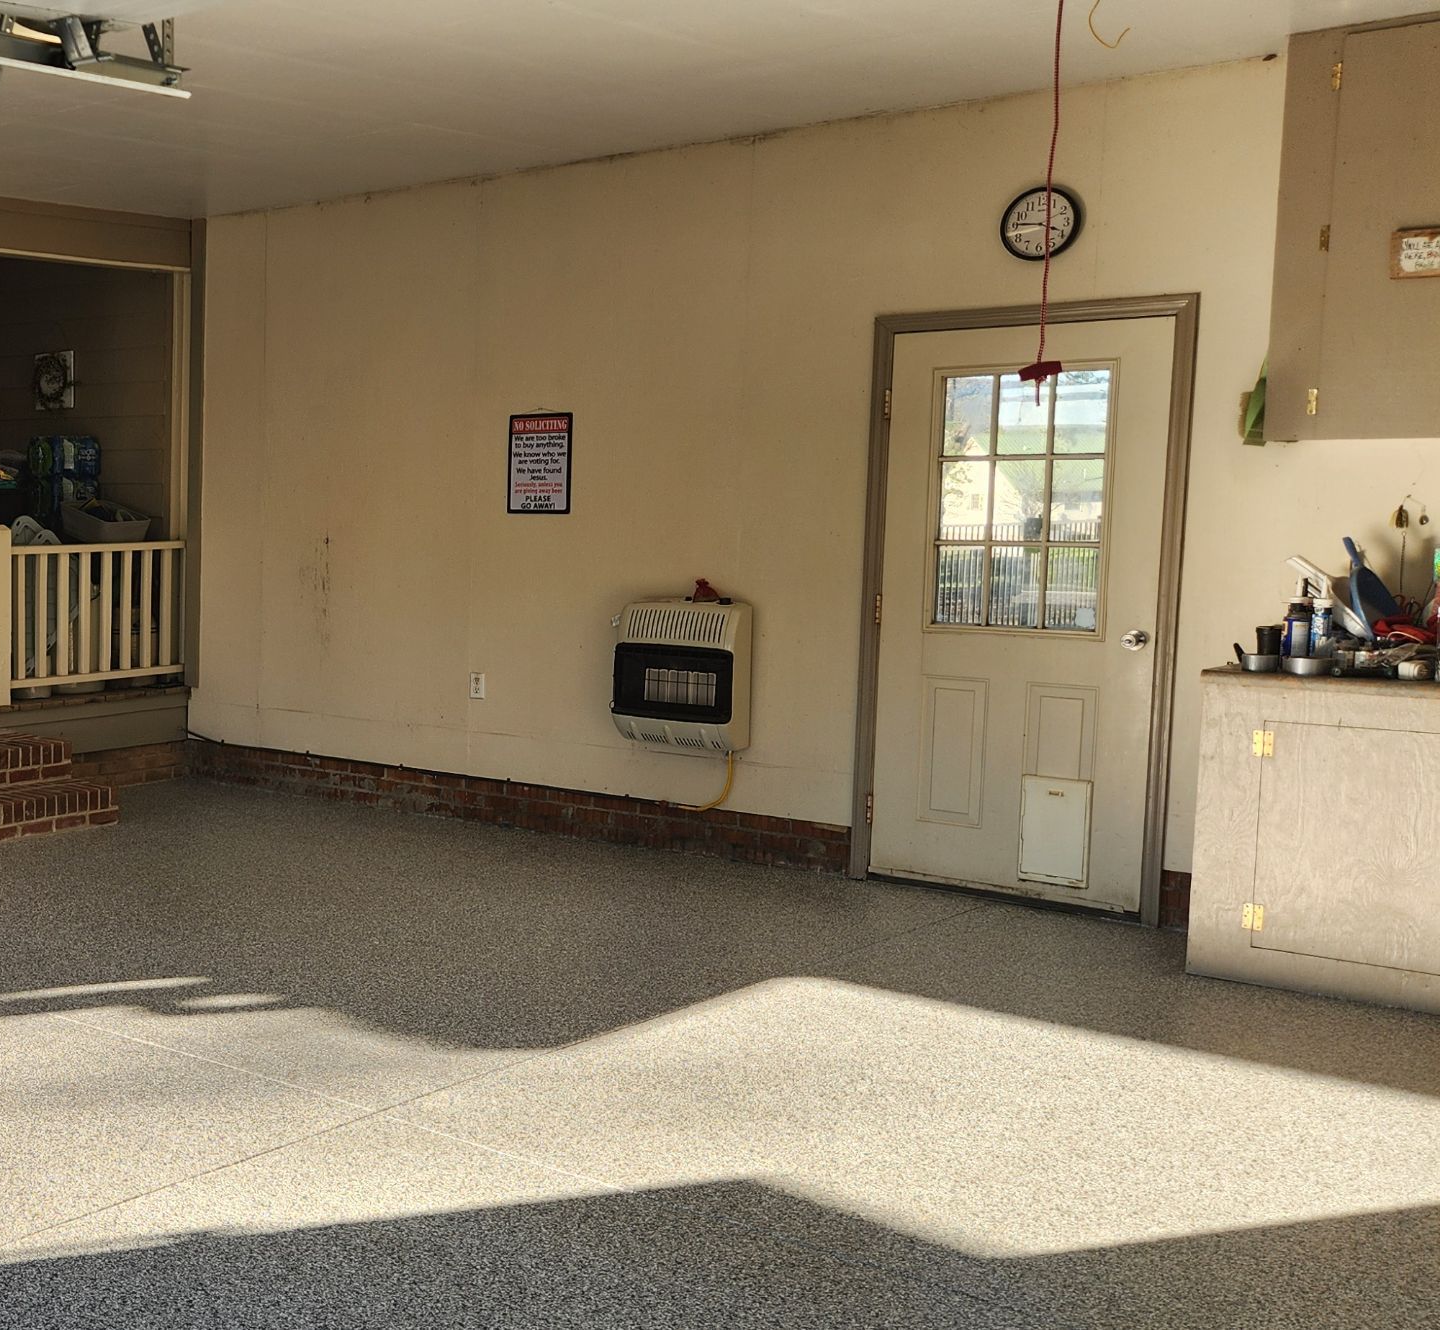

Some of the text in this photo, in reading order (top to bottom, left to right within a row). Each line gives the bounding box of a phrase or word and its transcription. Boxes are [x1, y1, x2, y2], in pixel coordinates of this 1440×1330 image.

[1026, 201, 1035, 211] 11
[1052, 199, 1057, 208] 1
[1060, 205, 1067, 215] 2
[1016, 211, 1027, 221] 10
[1012, 222, 1019, 230] 9
[1063, 217, 1070, 227] 3
[1014, 233, 1022, 243] 8
[1058, 229, 1065, 239] 4
[1024, 240, 1030, 250] 7
[1035, 242, 1042, 252] 6
[1048, 238, 1056, 248] 5
[514, 419, 567, 431] NO SOLICITING
[535, 441, 565, 449] anything.
